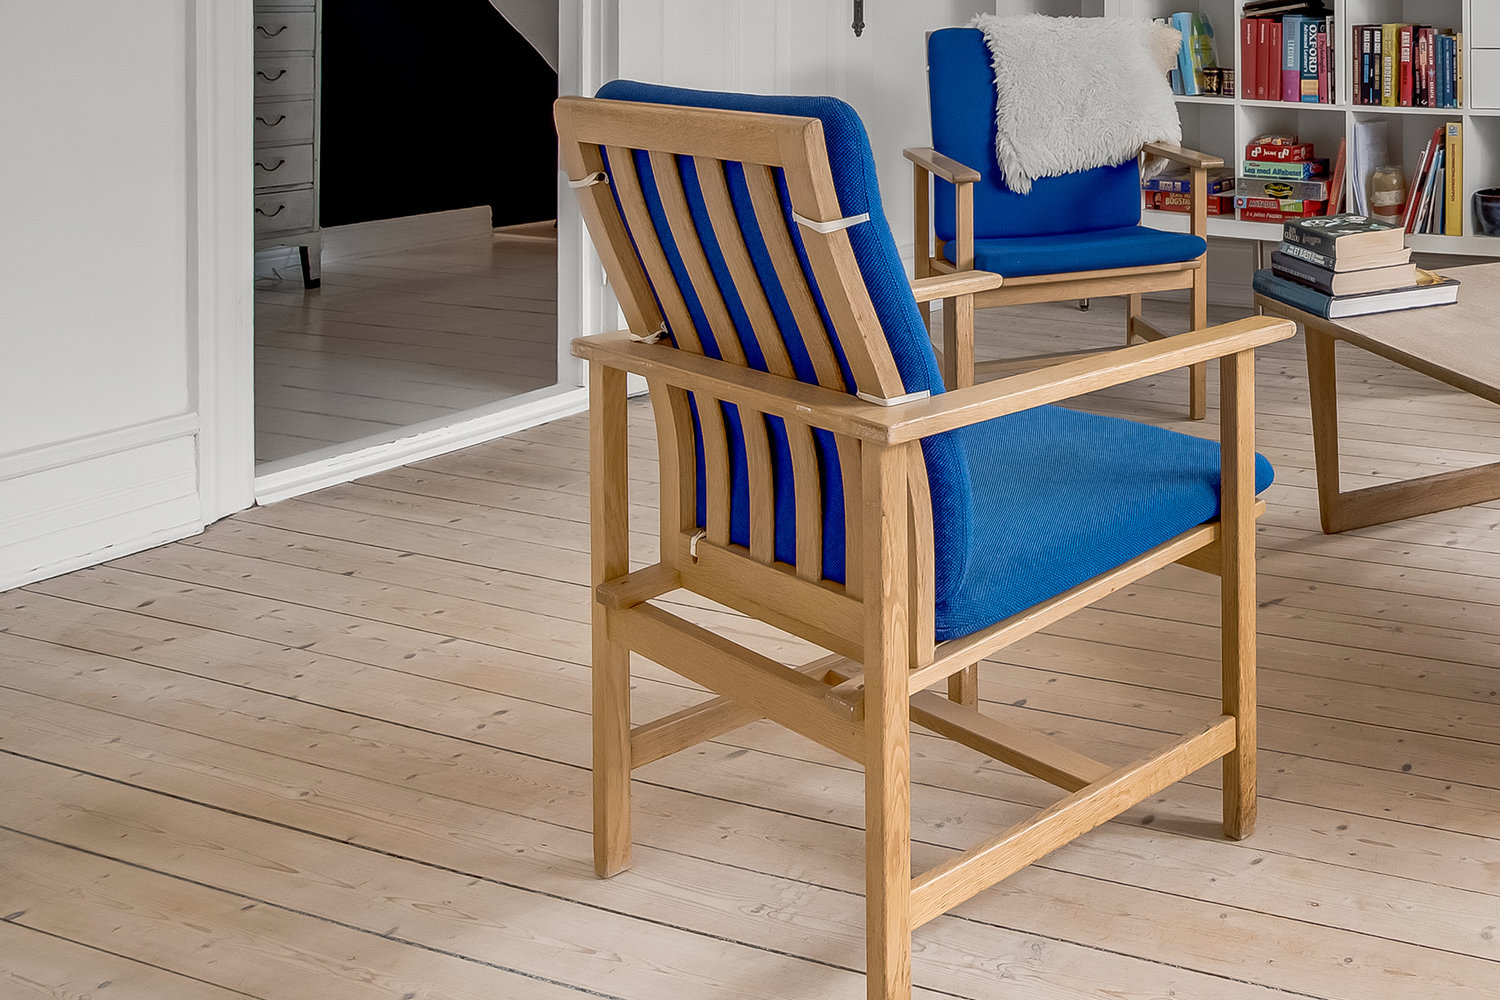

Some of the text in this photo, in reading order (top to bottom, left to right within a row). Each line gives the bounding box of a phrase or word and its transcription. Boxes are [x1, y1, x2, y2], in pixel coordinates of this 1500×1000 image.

[1401, 31, 1410, 47] ANNA
[1309, 24, 1317, 73] OXFORD
[1249, 200, 1278, 209] MATADOR
